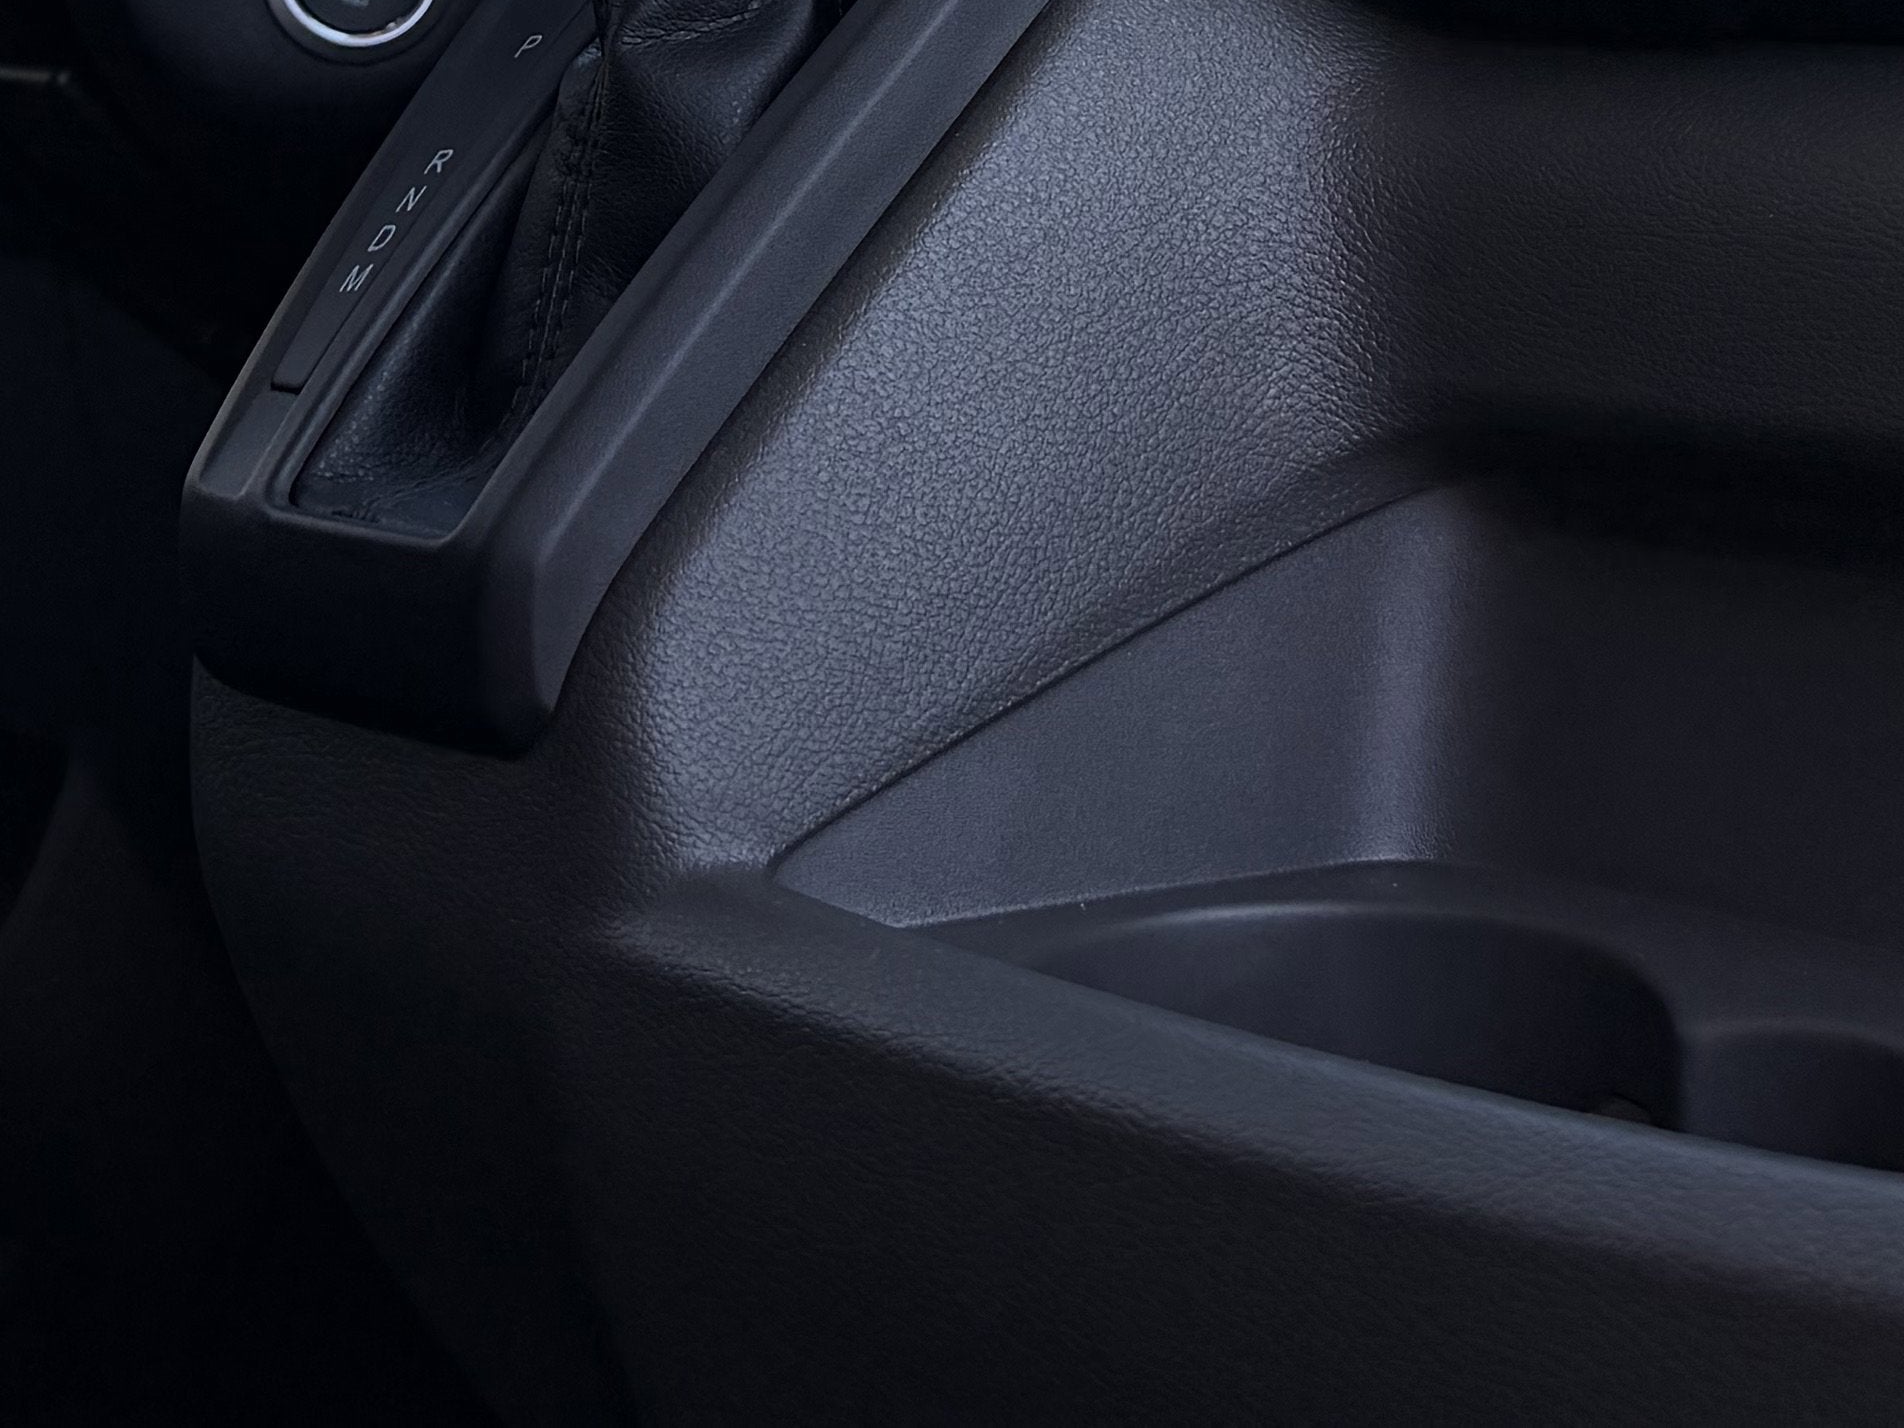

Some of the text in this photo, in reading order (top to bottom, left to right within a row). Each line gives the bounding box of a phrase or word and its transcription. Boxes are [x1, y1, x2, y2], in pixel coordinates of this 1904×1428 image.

[514, 35, 543, 59] P
[424, 149, 454, 174] R
[396, 185, 428, 212] N
[367, 225, 396, 252] D
[339, 264, 374, 292] M
